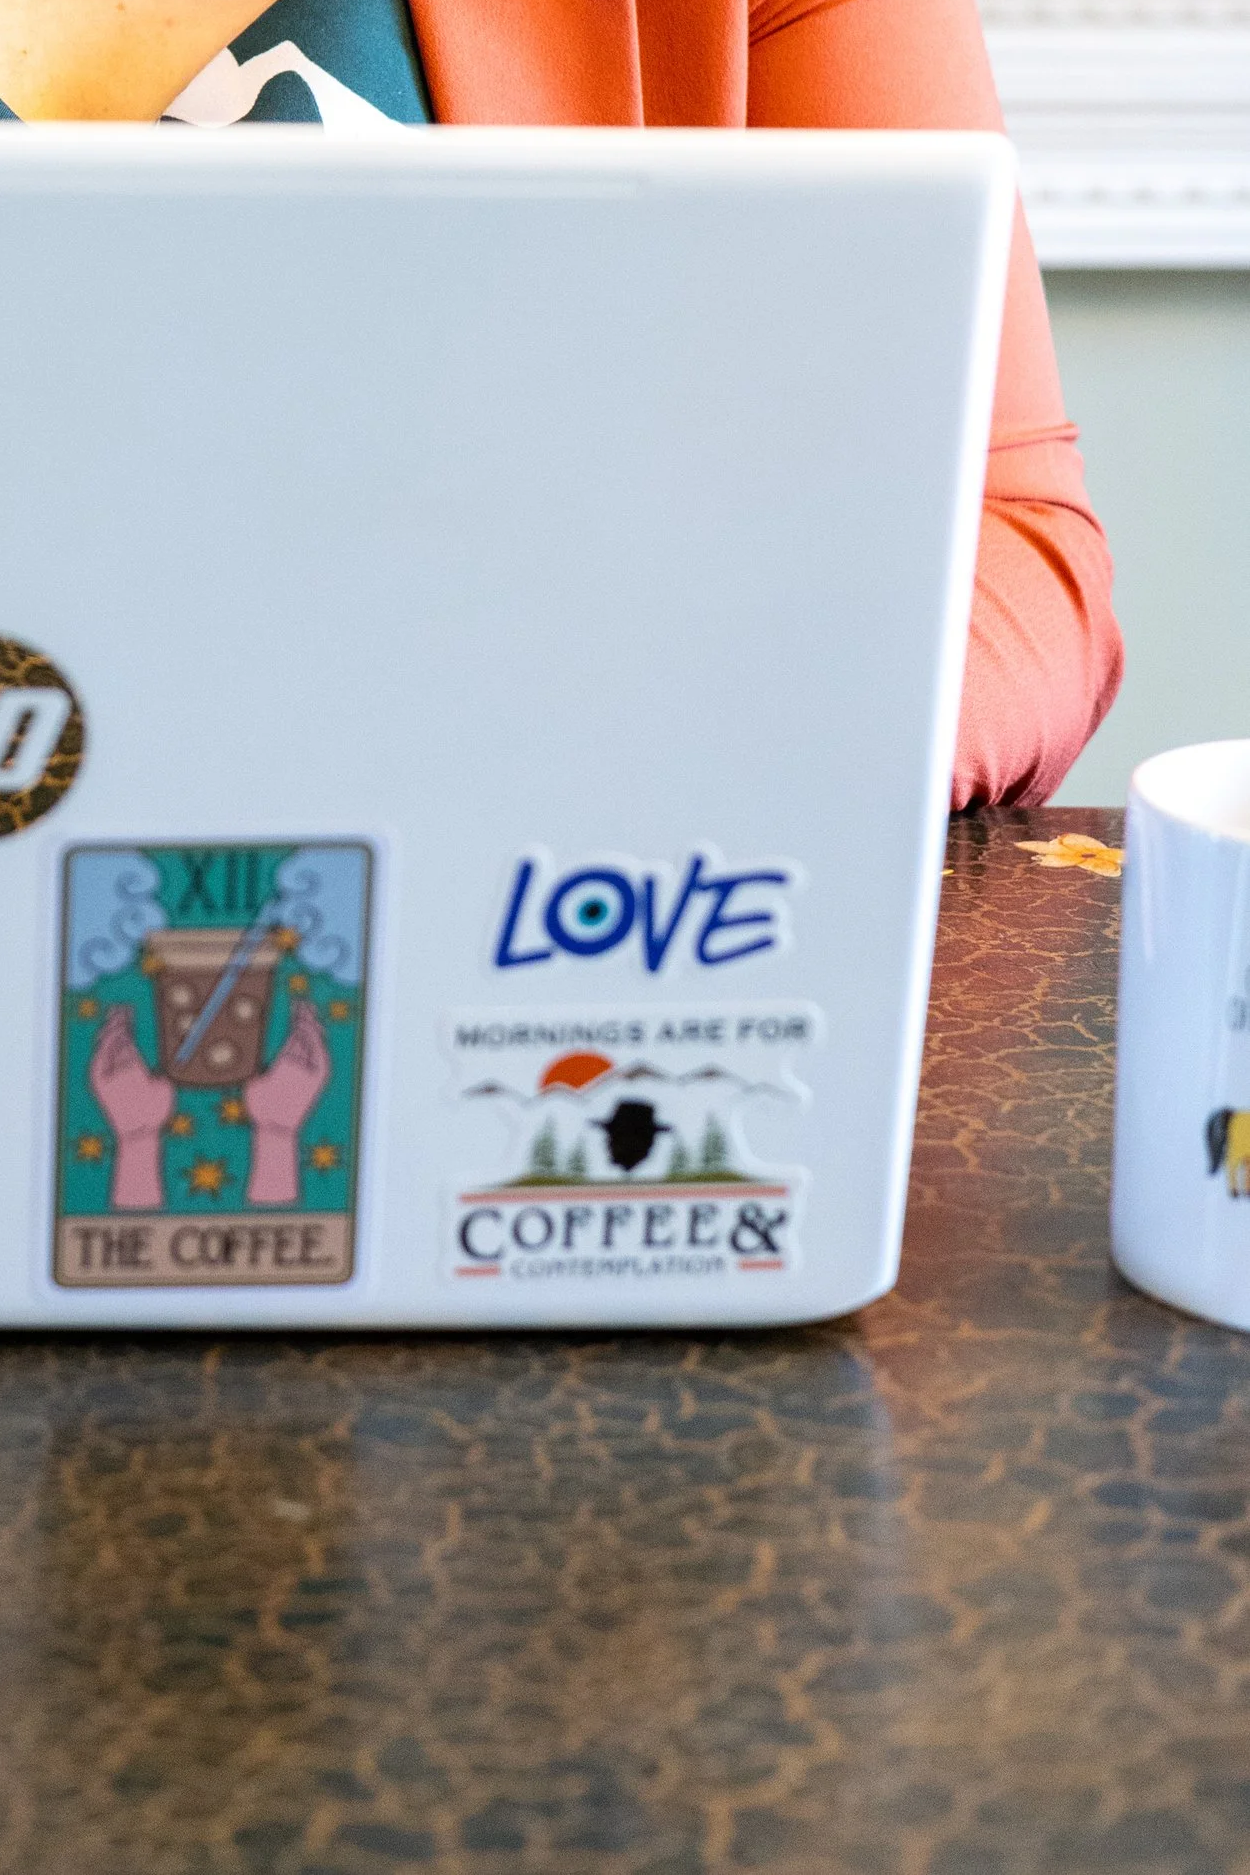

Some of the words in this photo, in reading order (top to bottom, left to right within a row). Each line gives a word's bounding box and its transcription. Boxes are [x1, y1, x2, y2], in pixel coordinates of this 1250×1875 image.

[493, 853, 789, 974] LOVE
[453, 1021, 644, 1049] MORNINGS
[653, 1018, 725, 1044] ARE
[736, 1016, 811, 1042] FOR
[72, 1224, 154, 1270] THE
